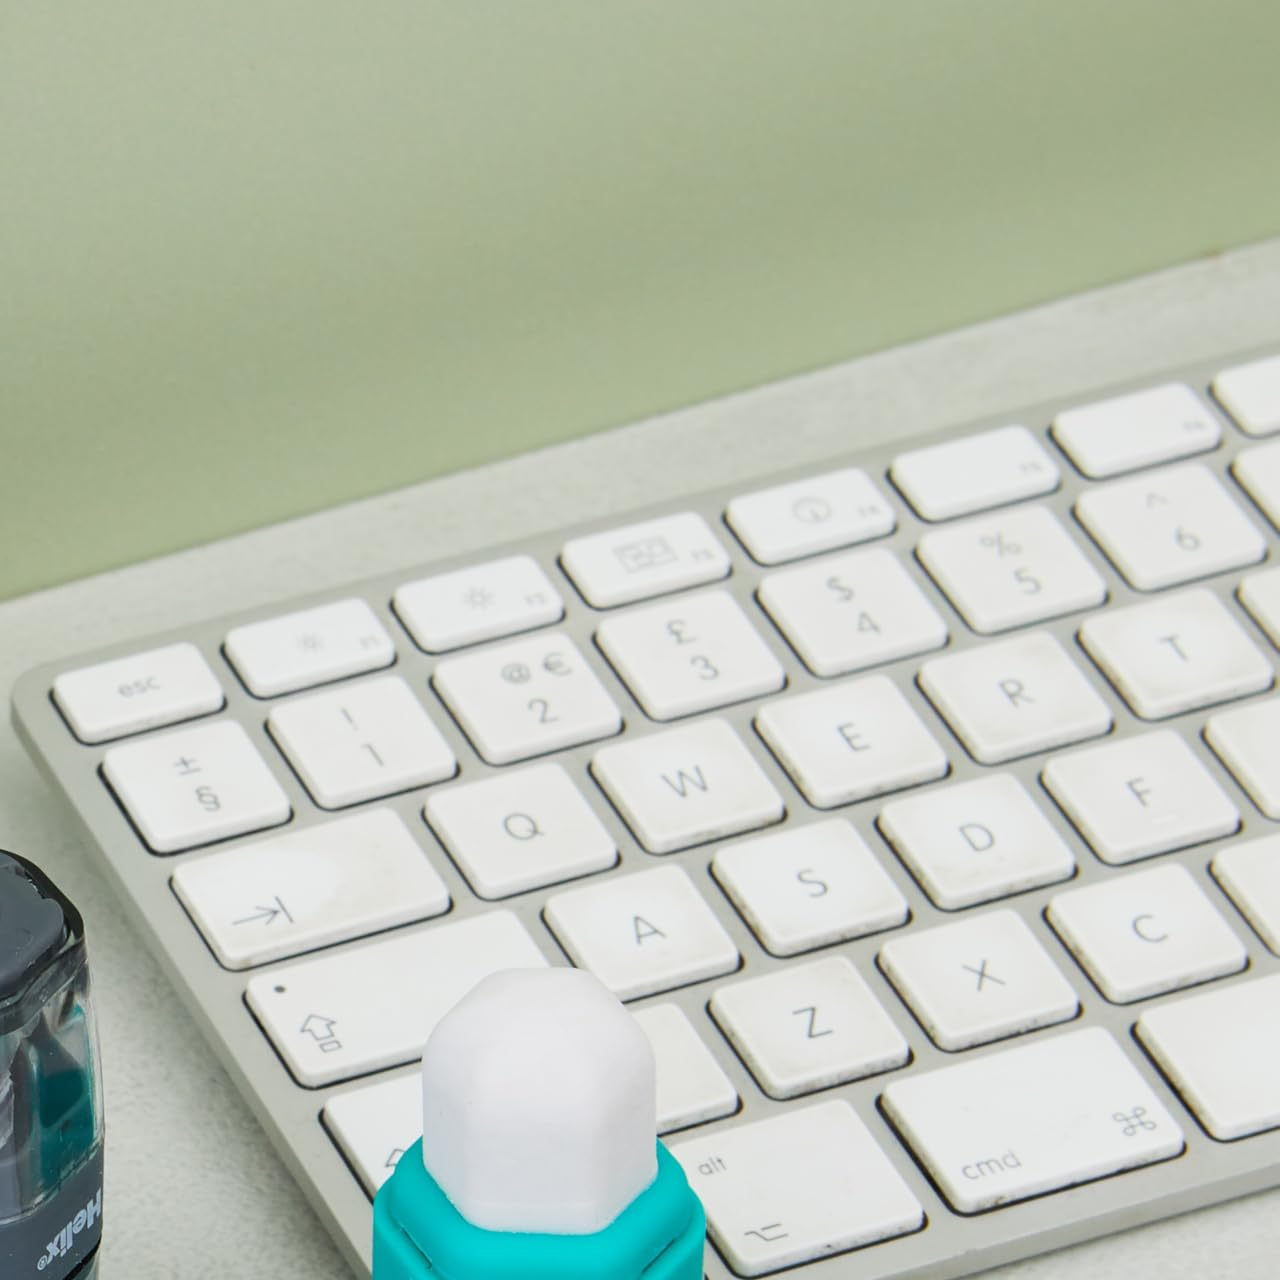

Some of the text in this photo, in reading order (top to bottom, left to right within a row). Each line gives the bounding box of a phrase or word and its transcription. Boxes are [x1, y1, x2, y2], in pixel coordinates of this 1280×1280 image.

[979, 531, 1022, 559] %
[1174, 526, 1202, 552] 6
[825, 575, 855, 603] $
[1013, 567, 1043, 596] 5
[665, 618, 696, 646] £
[855, 611, 882, 637] 4
[1160, 633, 1190, 663] T
[500, 652, 572, 686] @ €
[690, 654, 721, 682] 3
[117, 674, 161, 698] esc
[998, 678, 1033, 709] R
[527, 697, 560, 725] 2
[837, 722, 871, 753] E
[661, 765, 710, 799] W
[1125, 777, 1152, 808] F
[194, 785, 222, 813] §
[502, 812, 545, 841] Q
[958, 822, 996, 854] D
[796, 868, 830, 899] S
[632, 914, 667, 946] A
[1131, 913, 1170, 944] C
[962, 959, 1006, 993] X
[791, 1006, 833, 1040] Z
[697, 1156, 728, 1177] alt
[961, 1150, 1023, 1182] cmd
